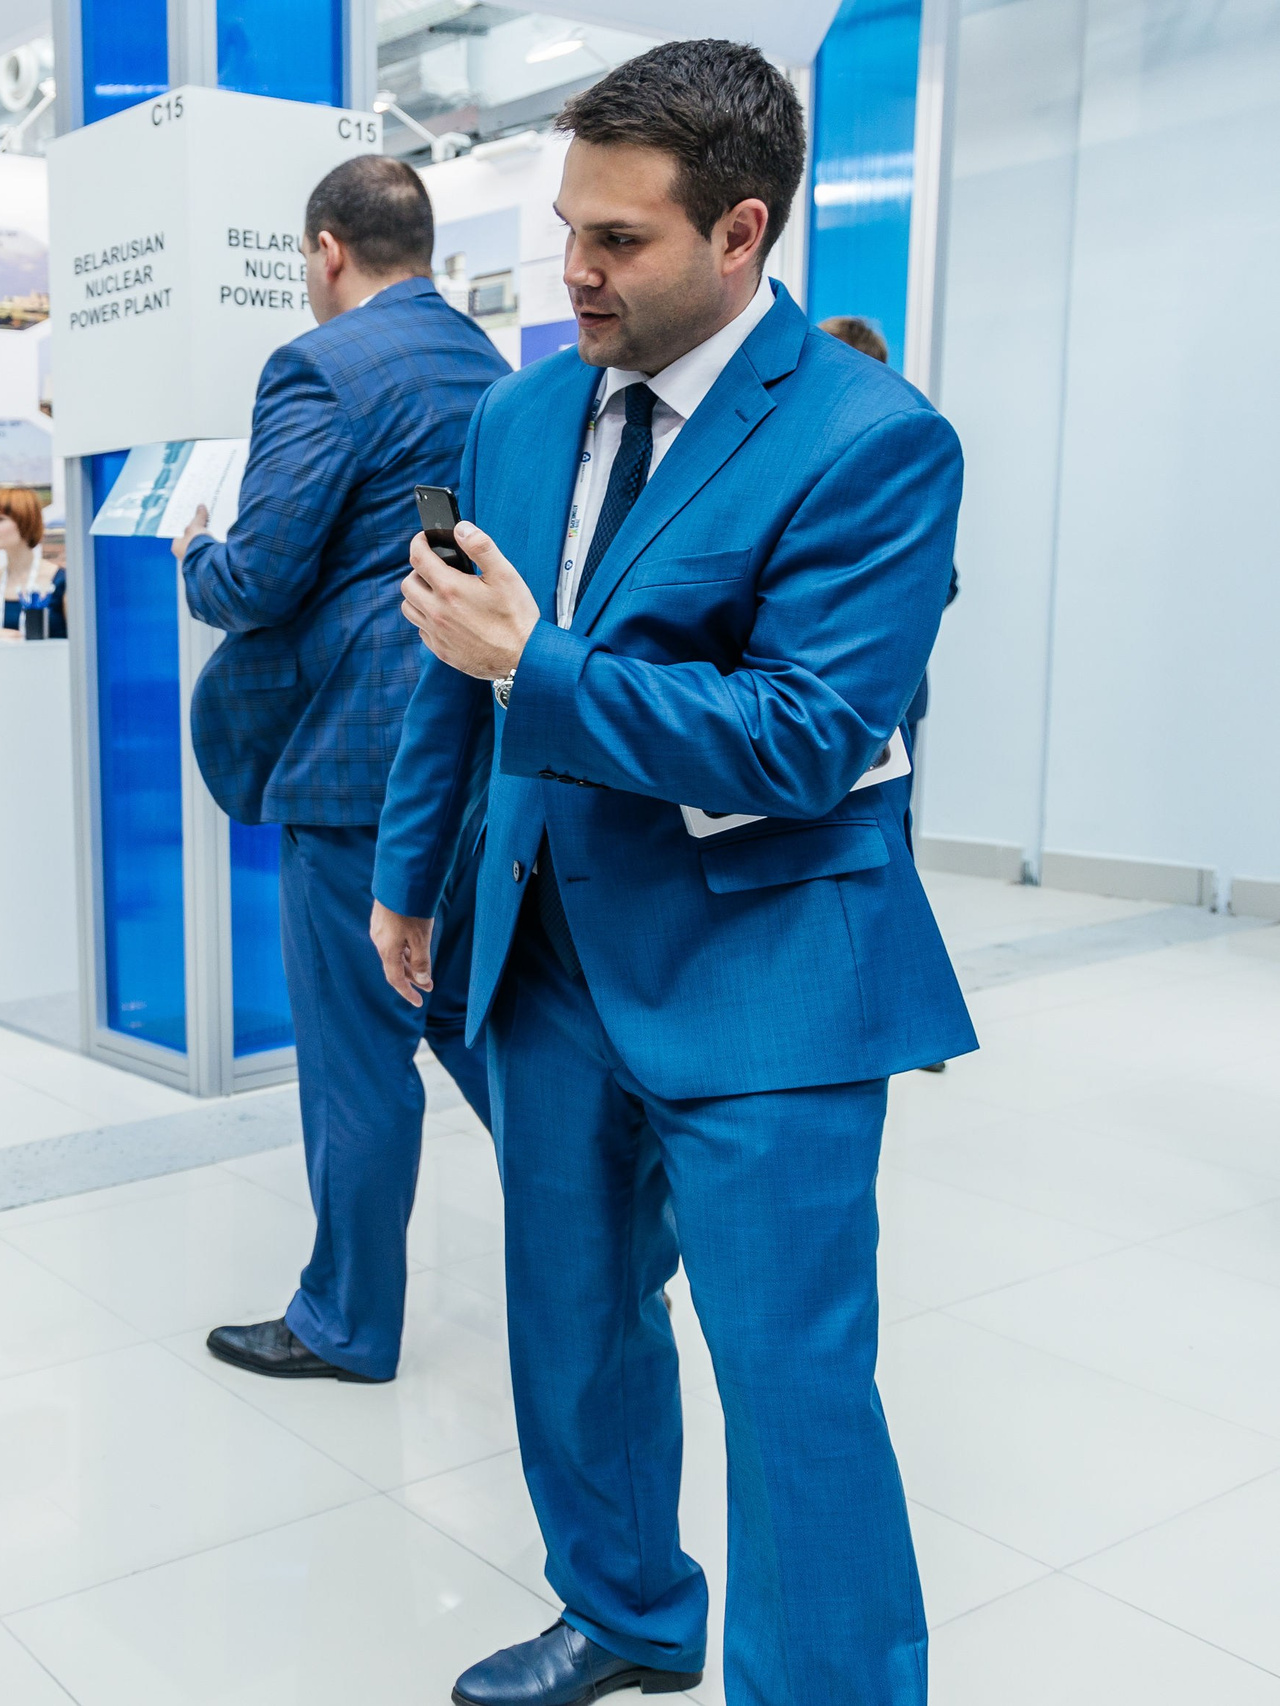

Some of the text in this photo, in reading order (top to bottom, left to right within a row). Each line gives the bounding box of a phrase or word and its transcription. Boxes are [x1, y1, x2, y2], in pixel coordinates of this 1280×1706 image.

[152, 95, 184, 126] C15
[338, 118, 377, 143] C15
[74, 231, 164, 275] BELARUSIAN
[228, 228, 303, 253] BELARU
[86, 264, 153, 299] NUCLEAR
[245, 259, 307, 282] NUCLE
[70, 287, 172, 330] POWER PLANT
[220, 285, 294, 309] POWER
